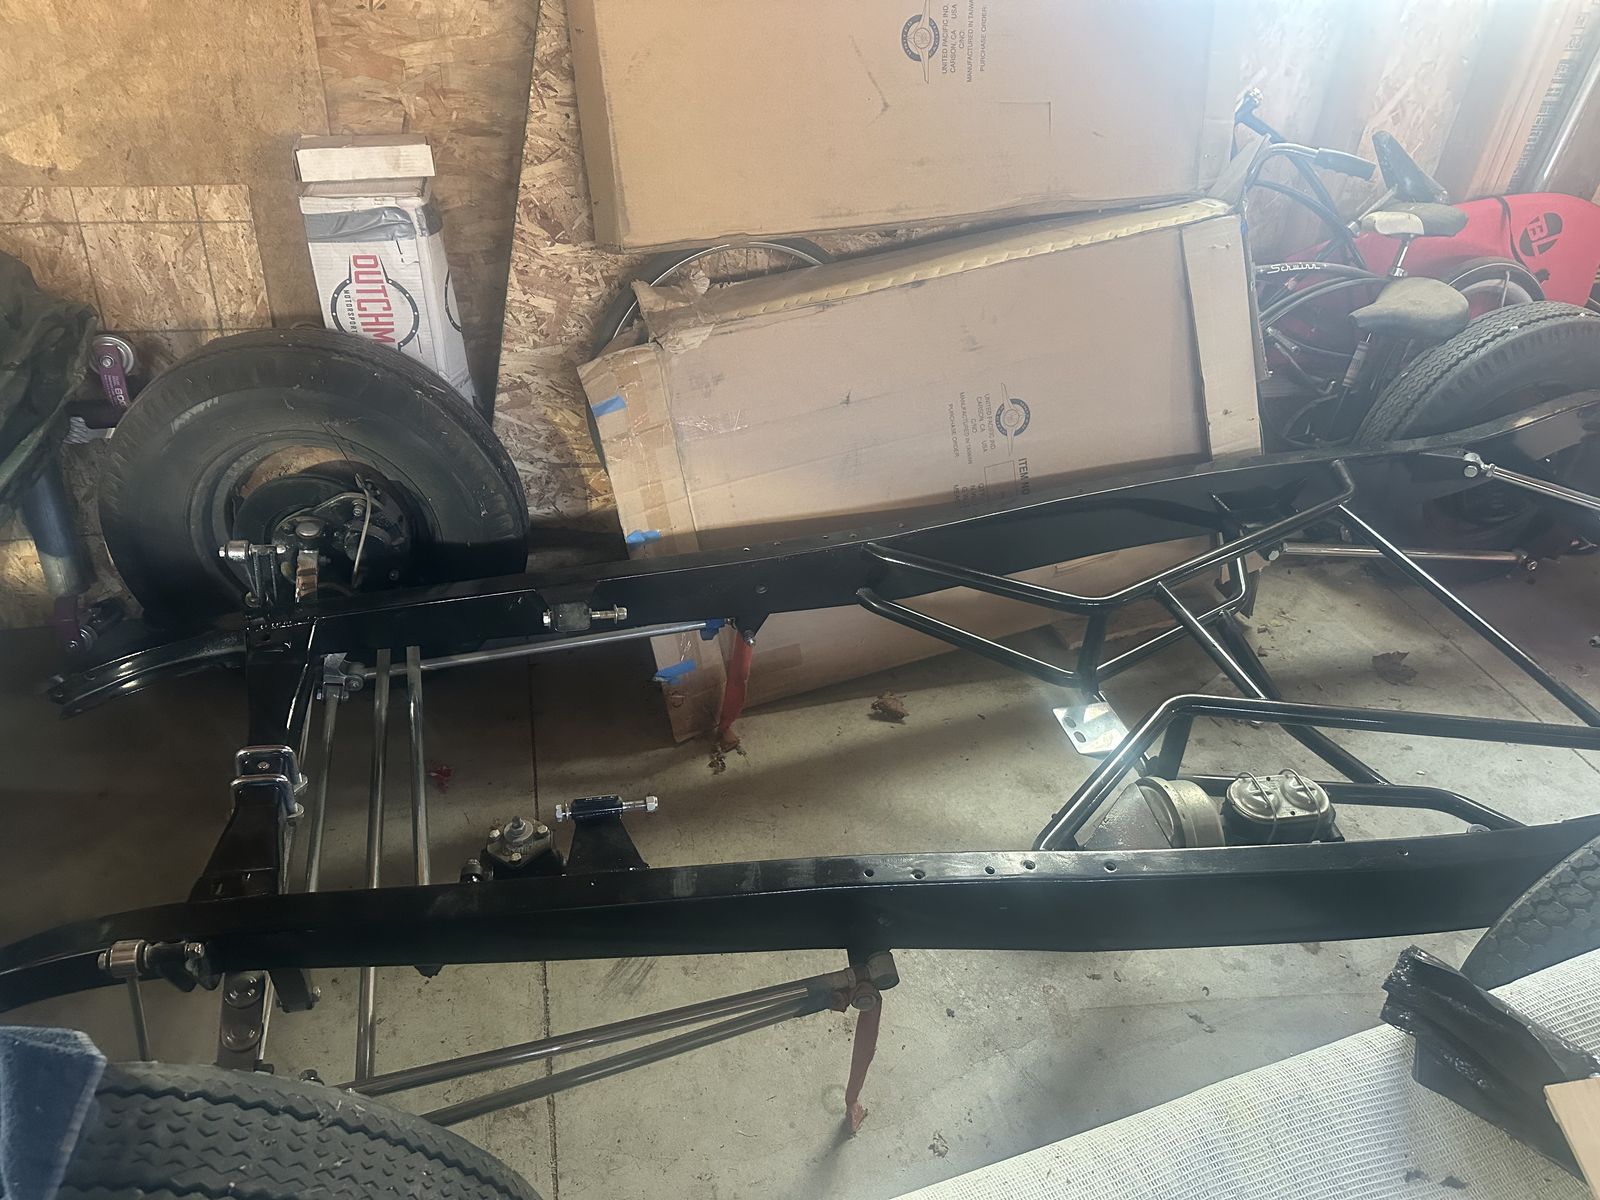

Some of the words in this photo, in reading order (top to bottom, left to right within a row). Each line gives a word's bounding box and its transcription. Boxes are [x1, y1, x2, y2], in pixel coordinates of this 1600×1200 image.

[966, 29, 974, 83] MANUFACTURED
[1266, 262, 1321, 274] Schwinn
[1018, 457, 1030, 480] ITEM
